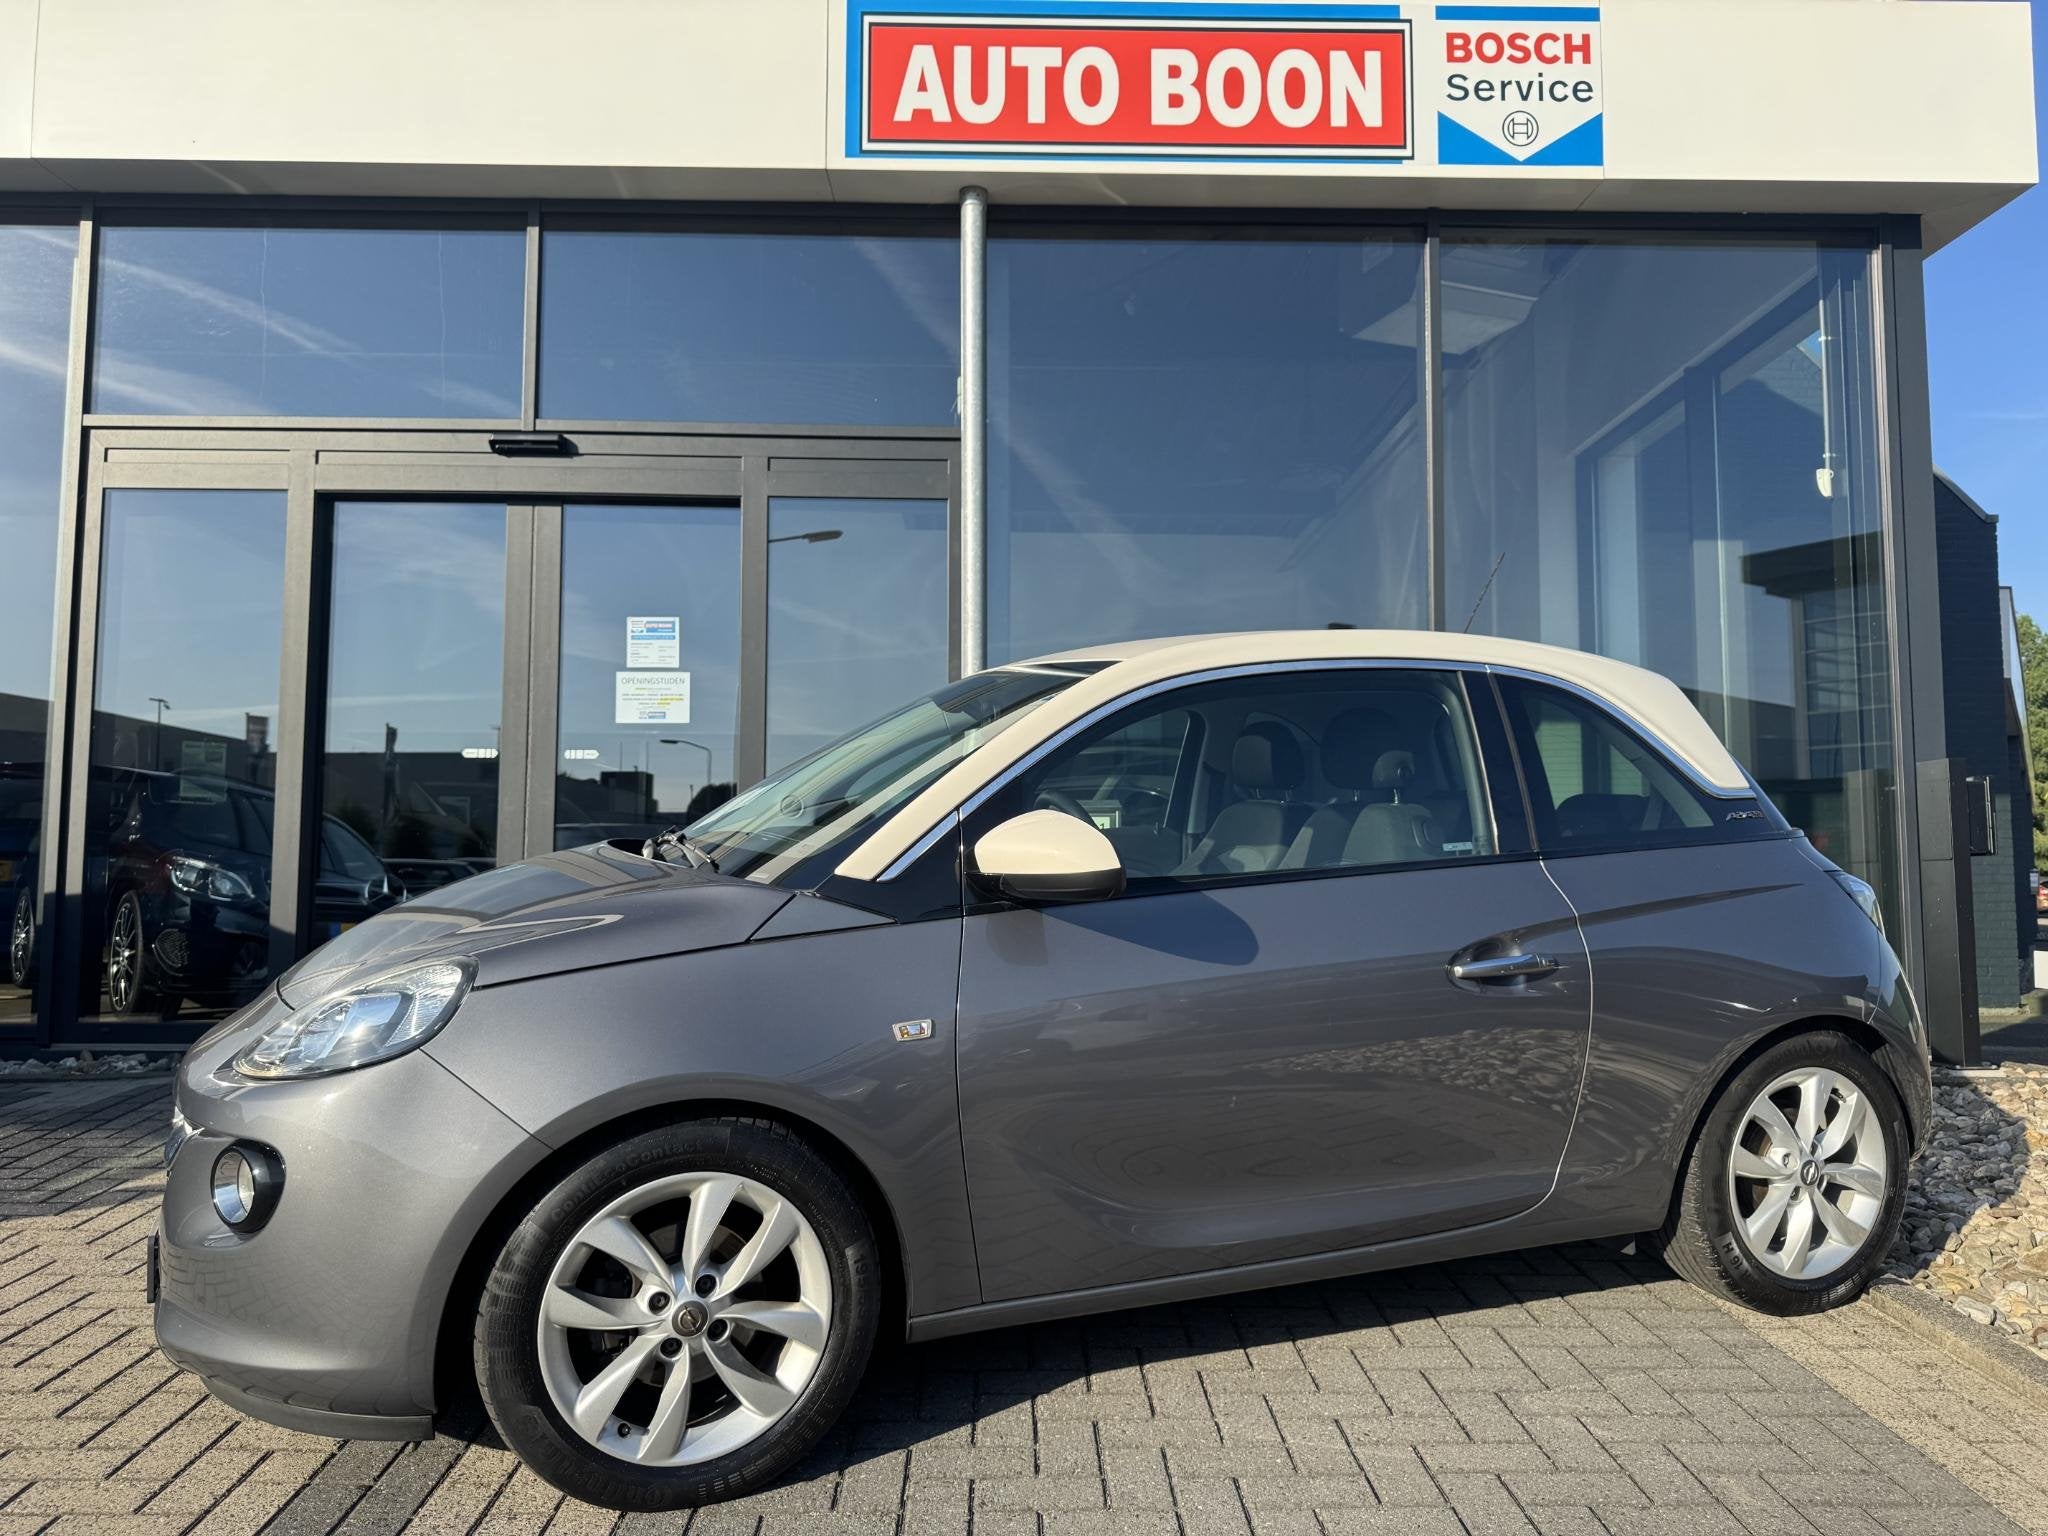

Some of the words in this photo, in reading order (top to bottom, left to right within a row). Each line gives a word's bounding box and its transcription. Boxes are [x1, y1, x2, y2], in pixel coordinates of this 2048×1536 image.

[1446, 32, 1592, 65] BOSCH
[893, 44, 1120, 125] AUTO
[1150, 49, 1383, 128] BOON
[1446, 73, 1595, 103] Service
[621, 676, 685, 685] OPENINGSTIJDEN
